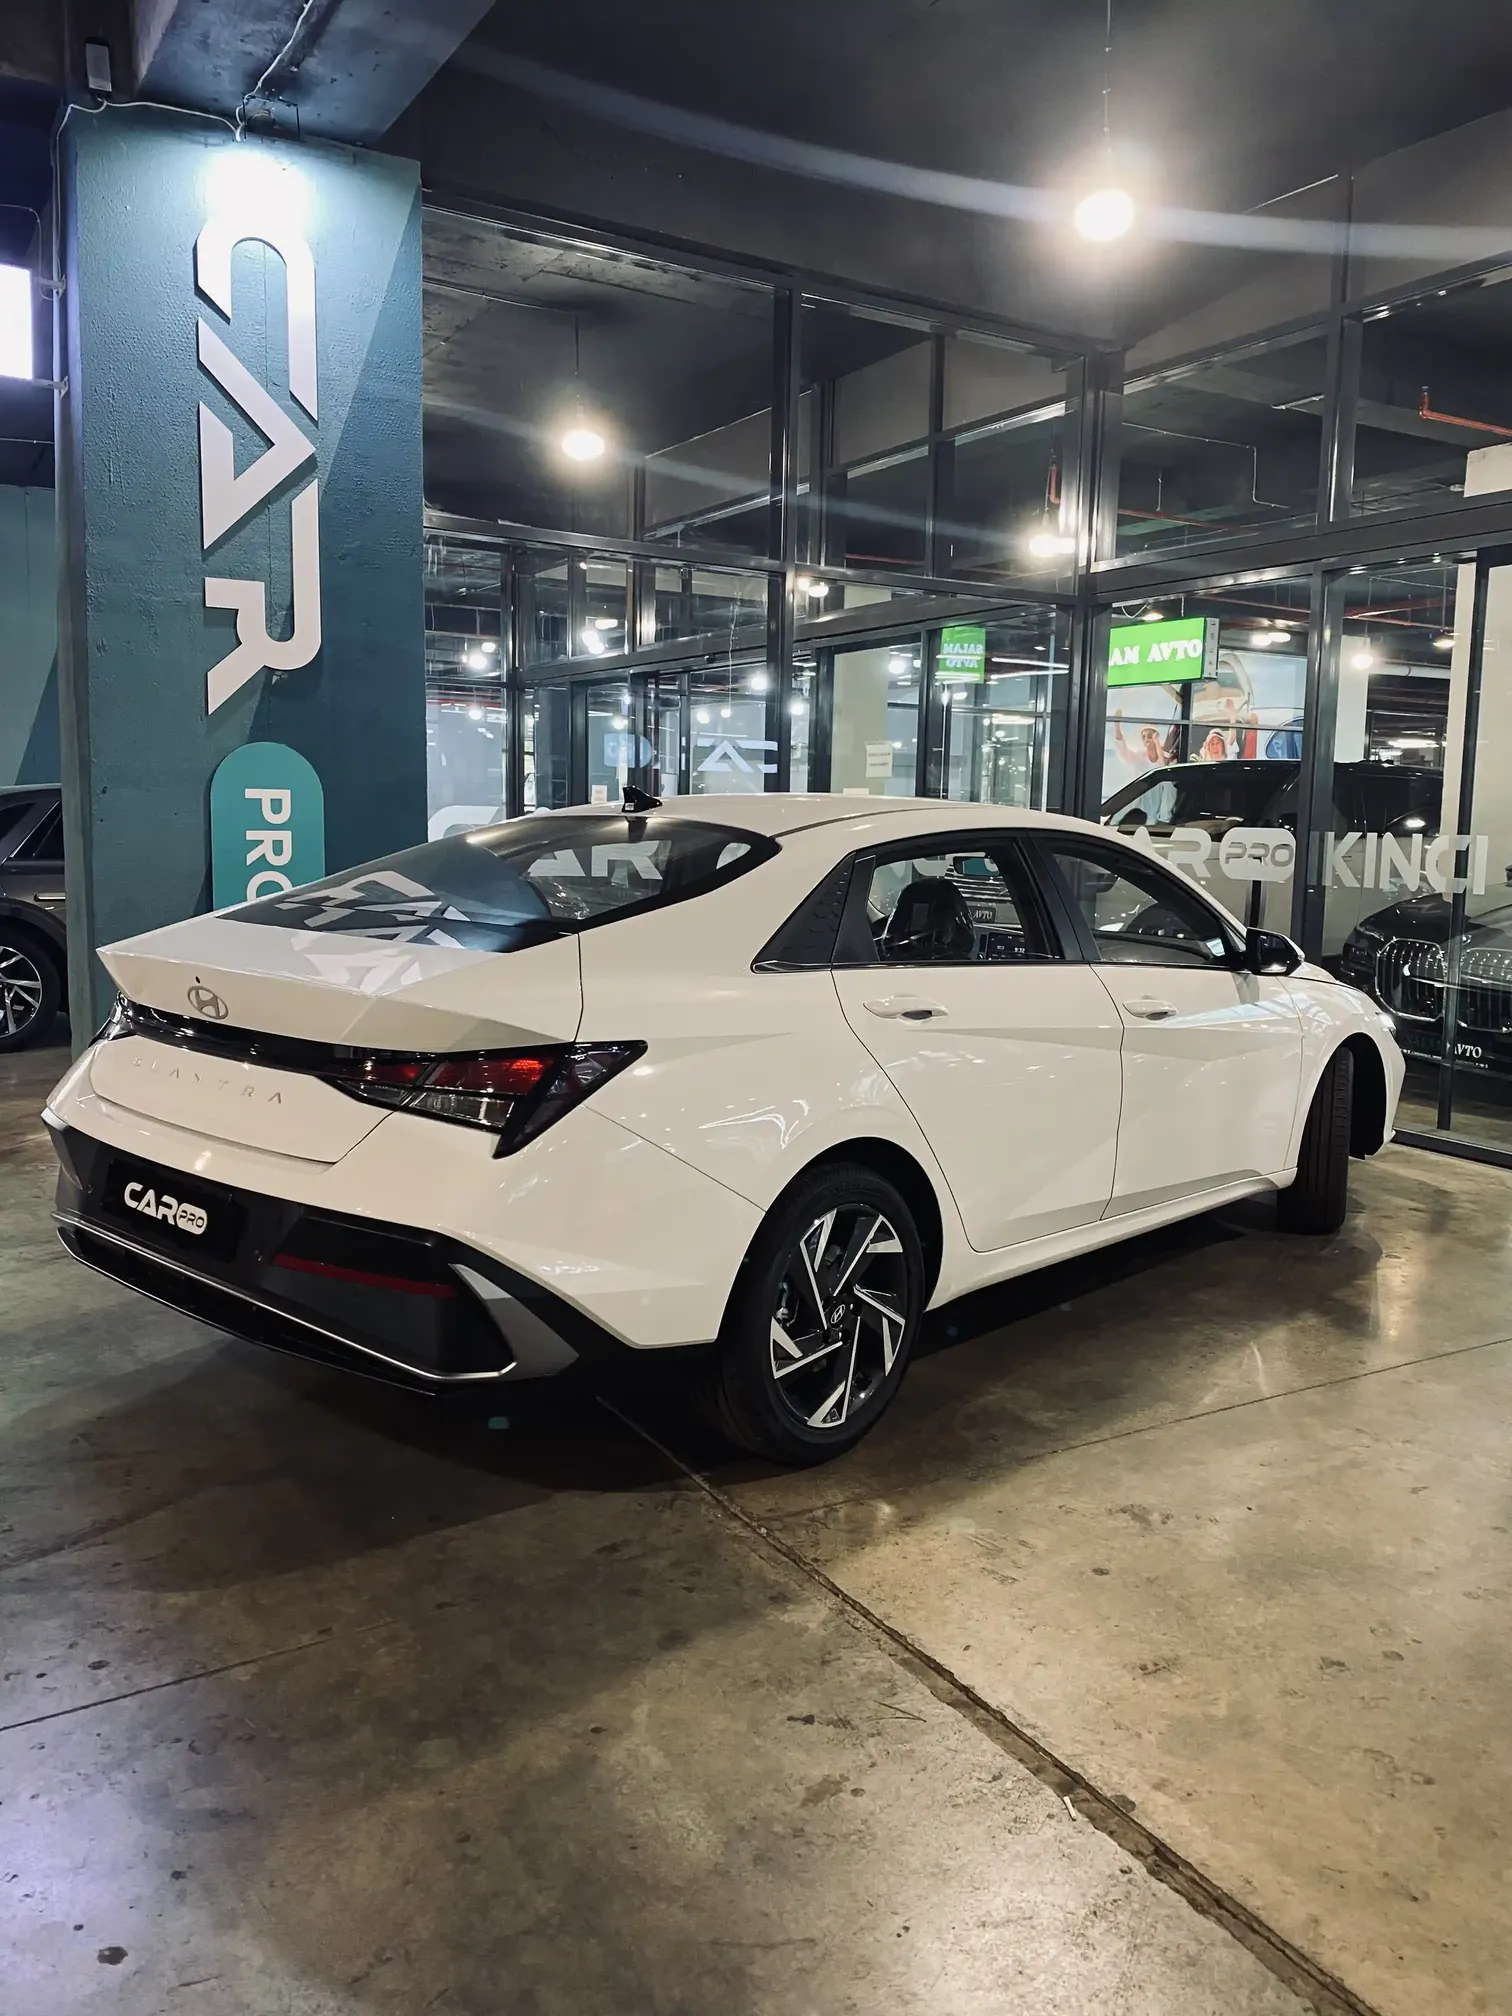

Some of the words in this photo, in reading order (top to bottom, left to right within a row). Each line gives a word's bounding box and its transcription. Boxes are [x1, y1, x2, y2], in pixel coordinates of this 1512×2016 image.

[196, 212, 322, 716] CAR
[1147, 639, 1203, 662] AVTO
[245, 788, 293, 901] PRO
[1224, 841, 1294, 868] PRO
[132, 1057, 282, 1104] ELANTRA
[124, 1182, 178, 1225] CAR
[178, 1209, 205, 1228] PRO
